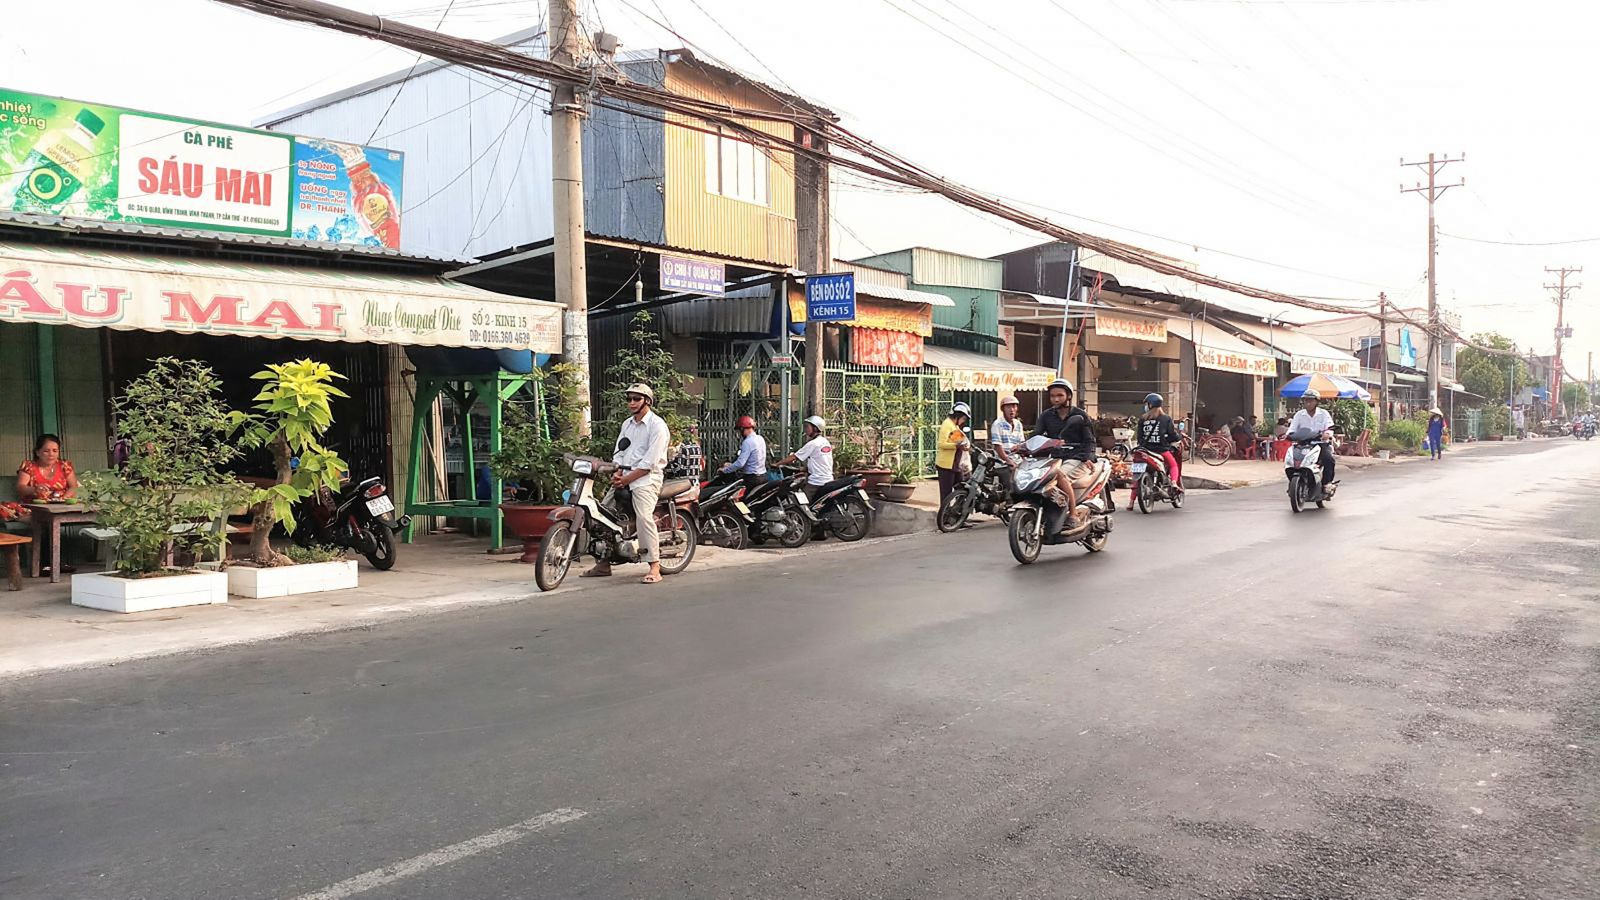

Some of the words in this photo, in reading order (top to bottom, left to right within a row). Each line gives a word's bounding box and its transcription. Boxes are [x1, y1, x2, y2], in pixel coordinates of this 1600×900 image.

[184, 129, 203, 146] CÀ
[208, 135, 233, 150] PHÊ
[138, 155, 204, 198] SÁU
[215, 166, 272, 207] MAI
[317, 203, 346, 214] THANH
[811, 278, 824, 301] BẾN
[835, 276, 845, 300] SỐ
[845, 281, 851, 299] 2
[162, 289, 347, 336] MAI
[394, 303, 438, 334] Compact
[439, 306, 461, 331] Disc
[472, 308, 483, 326] SỐ
[484, 315, 490, 326] 2
[495, 314, 516, 328] KINH
[518, 317, 527, 328] 15
[813, 306, 837, 316] KÊNH
[839, 306, 849, 315] 15
[515, 332, 530, 344] 4639
